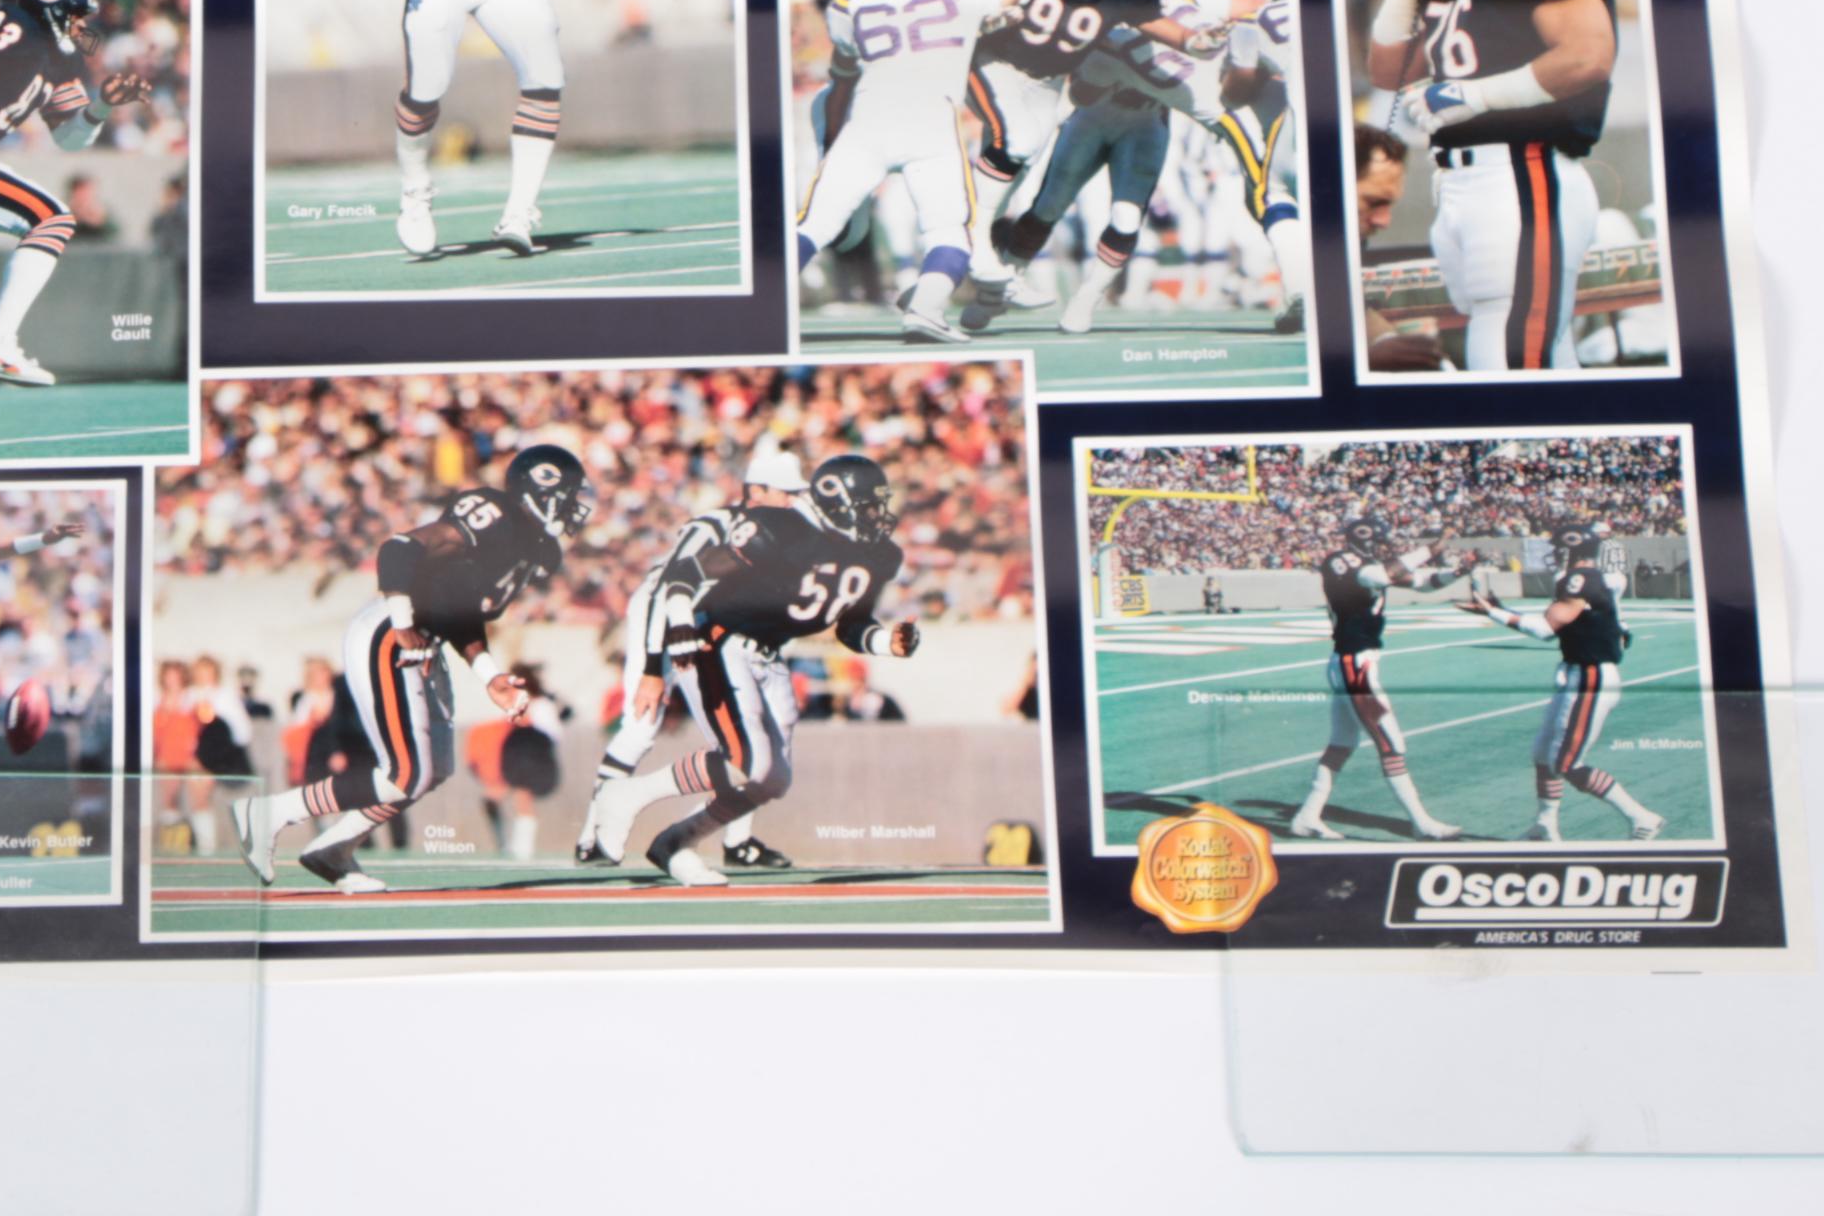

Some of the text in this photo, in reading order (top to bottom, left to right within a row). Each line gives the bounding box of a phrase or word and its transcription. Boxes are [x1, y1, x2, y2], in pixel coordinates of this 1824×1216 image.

[287, 203, 377, 220] Gary Fencik
[111, 313, 153, 327] Willie
[111, 327, 152, 342] Gault
[1121, 347, 1228, 364] Dan Hampton
[1566, 573, 1586, 594] 9
[786, 562, 872, 625] 58
[1609, 738, 1704, 751] Jim McMahon
[423, 823, 456, 839] Otis
[815, 824, 937, 840] Wilber Marshall
[46, 833, 94, 849] Butler
[422, 839, 476, 855] Wilson
[1178, 836, 1233, 857] Kodak
[1475, 930, 1642, 944] AMERICA'S DRUG STORE
